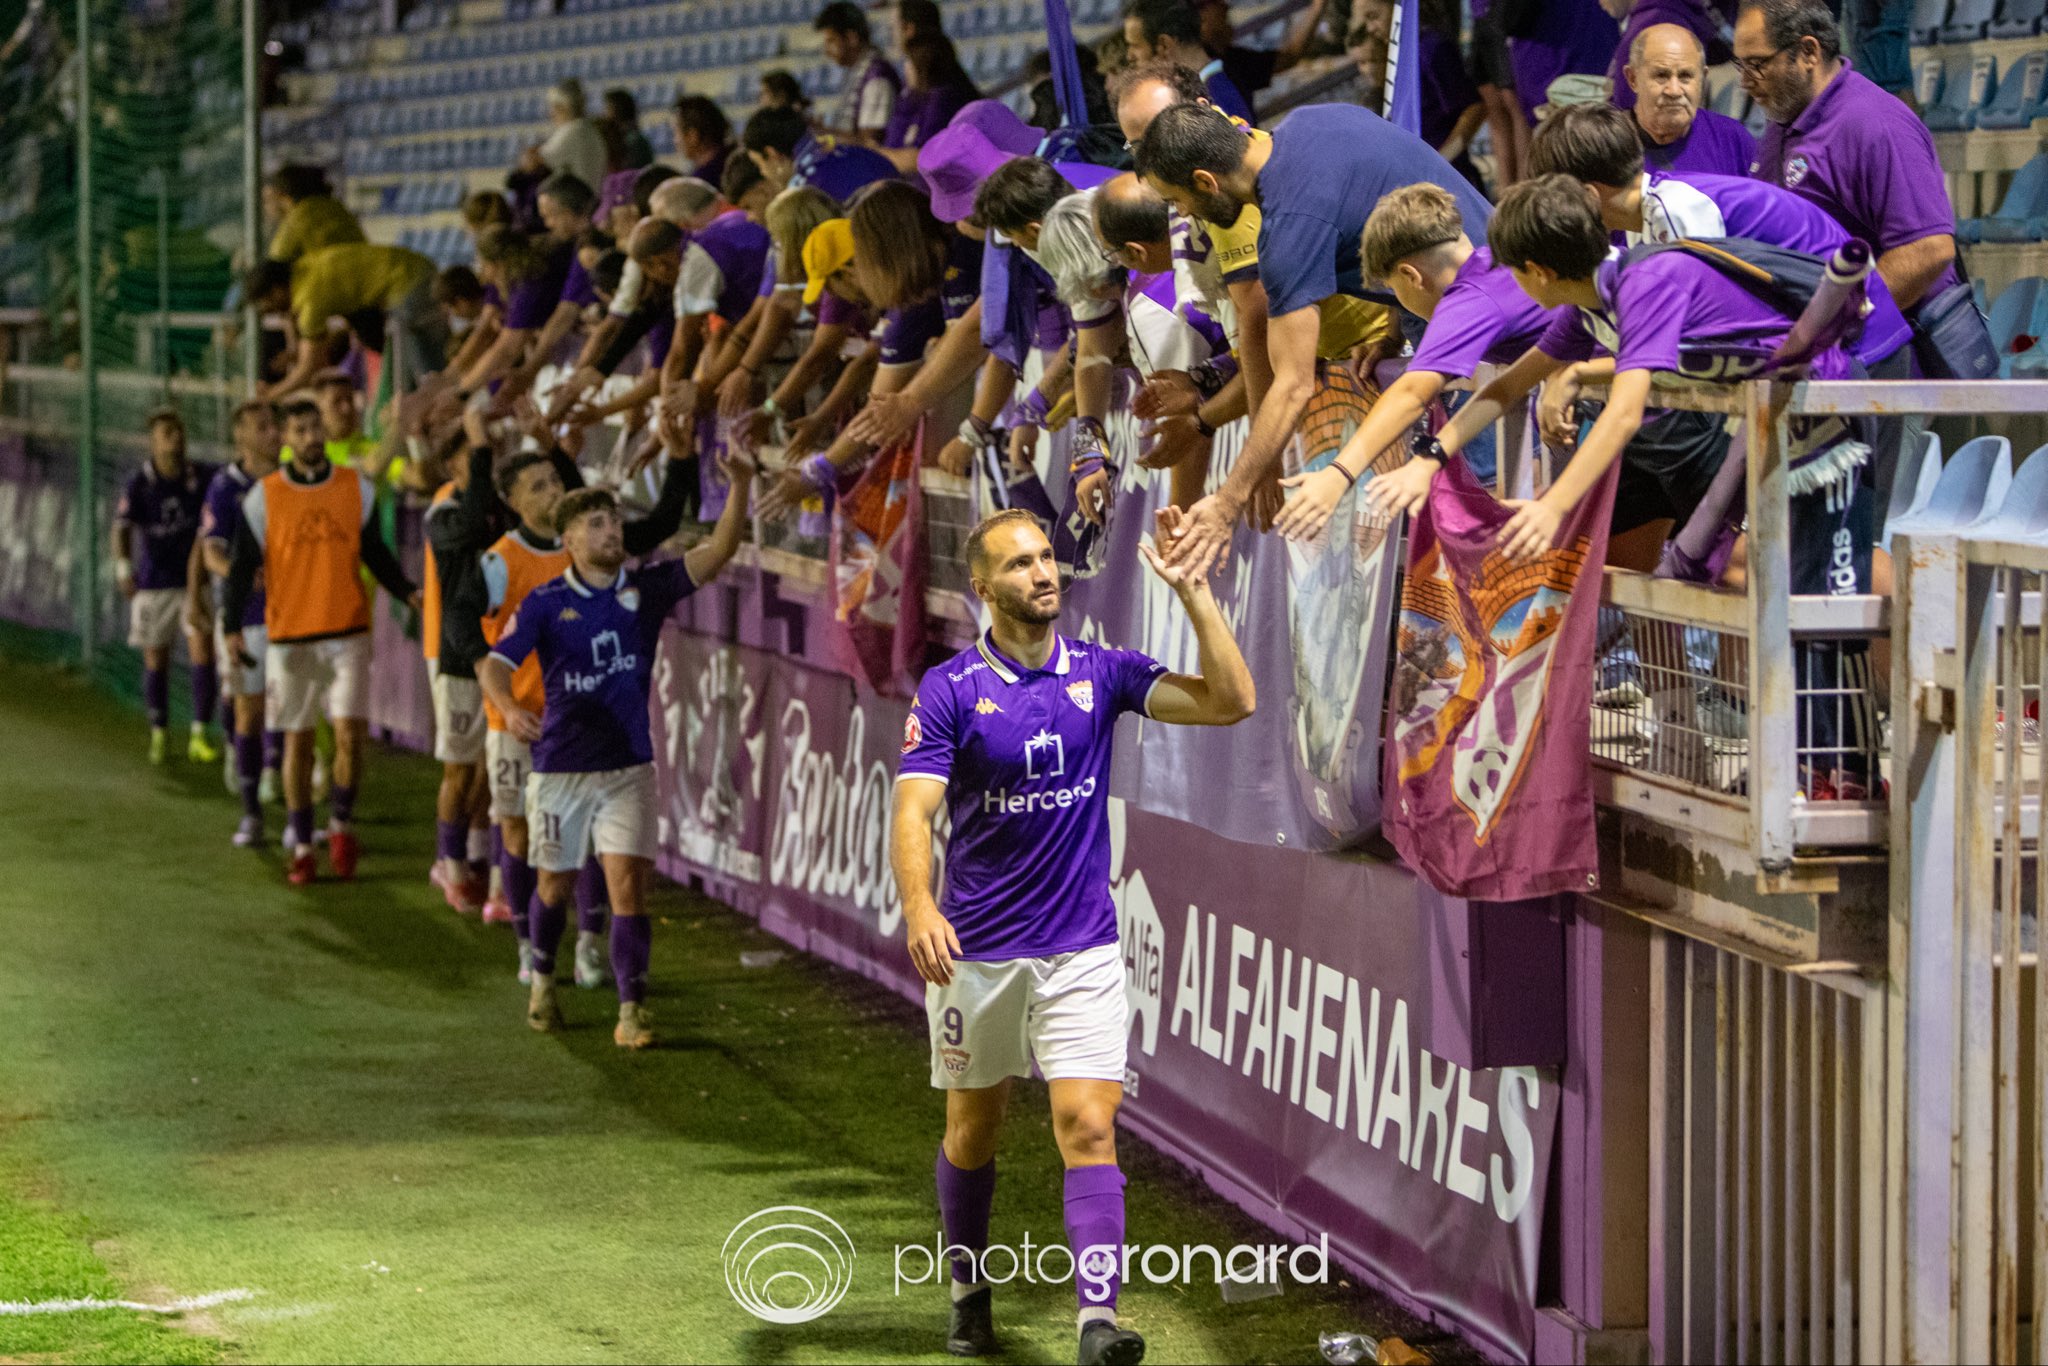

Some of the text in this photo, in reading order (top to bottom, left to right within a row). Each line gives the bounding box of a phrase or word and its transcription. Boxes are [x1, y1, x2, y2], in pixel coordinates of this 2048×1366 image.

[1215, 243, 1256, 262] BRO
[1831, 527, 1857, 596] idas
[496, 758, 522, 786] 21
[1125, 914, 1160, 998] Alfa
[944, 1006, 963, 1046] 9
[1169, 903, 1541, 1224] ALFAHENARES
